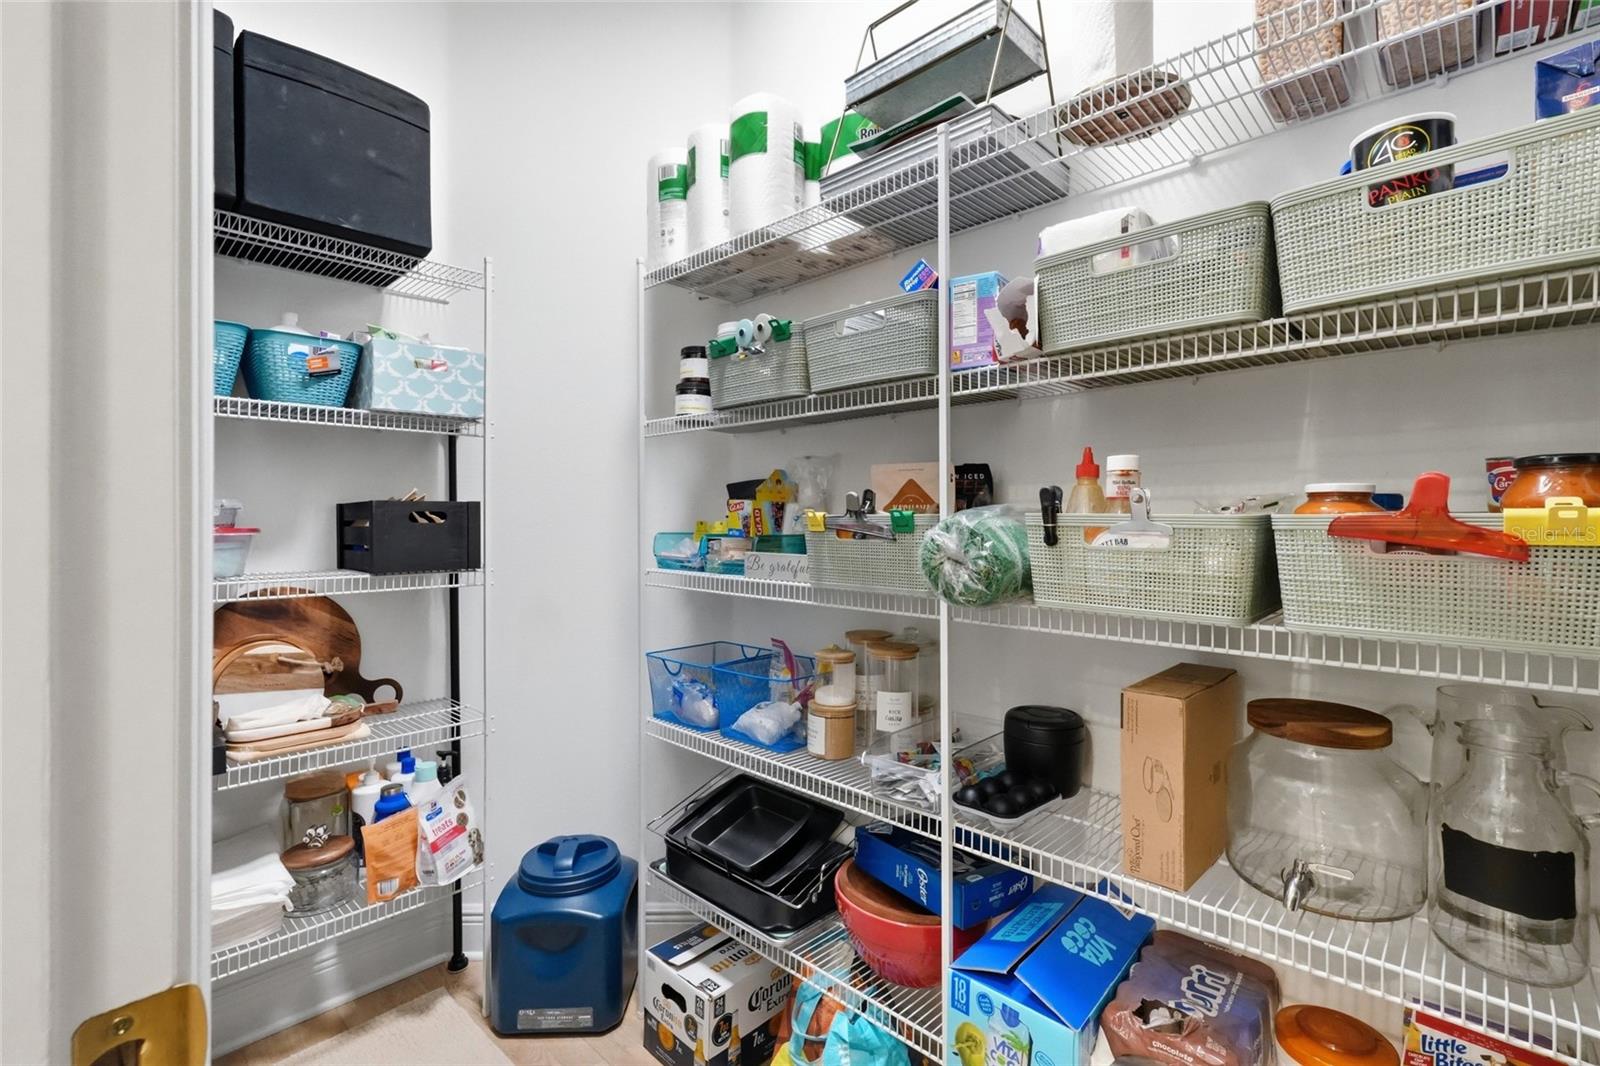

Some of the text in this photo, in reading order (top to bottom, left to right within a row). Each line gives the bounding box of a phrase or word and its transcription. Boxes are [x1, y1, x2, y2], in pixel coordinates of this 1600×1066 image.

[1369, 167, 1440, 205] PANKO
[1387, 185, 1427, 205] PLAIN
[964, 472, 985, 480] ICED
[747, 554, 765, 571] Be
[432, 818, 454, 837] treats
[916, 867, 928, 906] Oster
[1061, 916, 1097, 955] COCO
[1079, 934, 1118, 968] VITA
[954, 977, 967, 1004] 18
[954, 1001, 968, 1012] PACK
[1152, 1040, 1194, 1063] chocolate
[1421, 1034, 1468, 1054] Little
